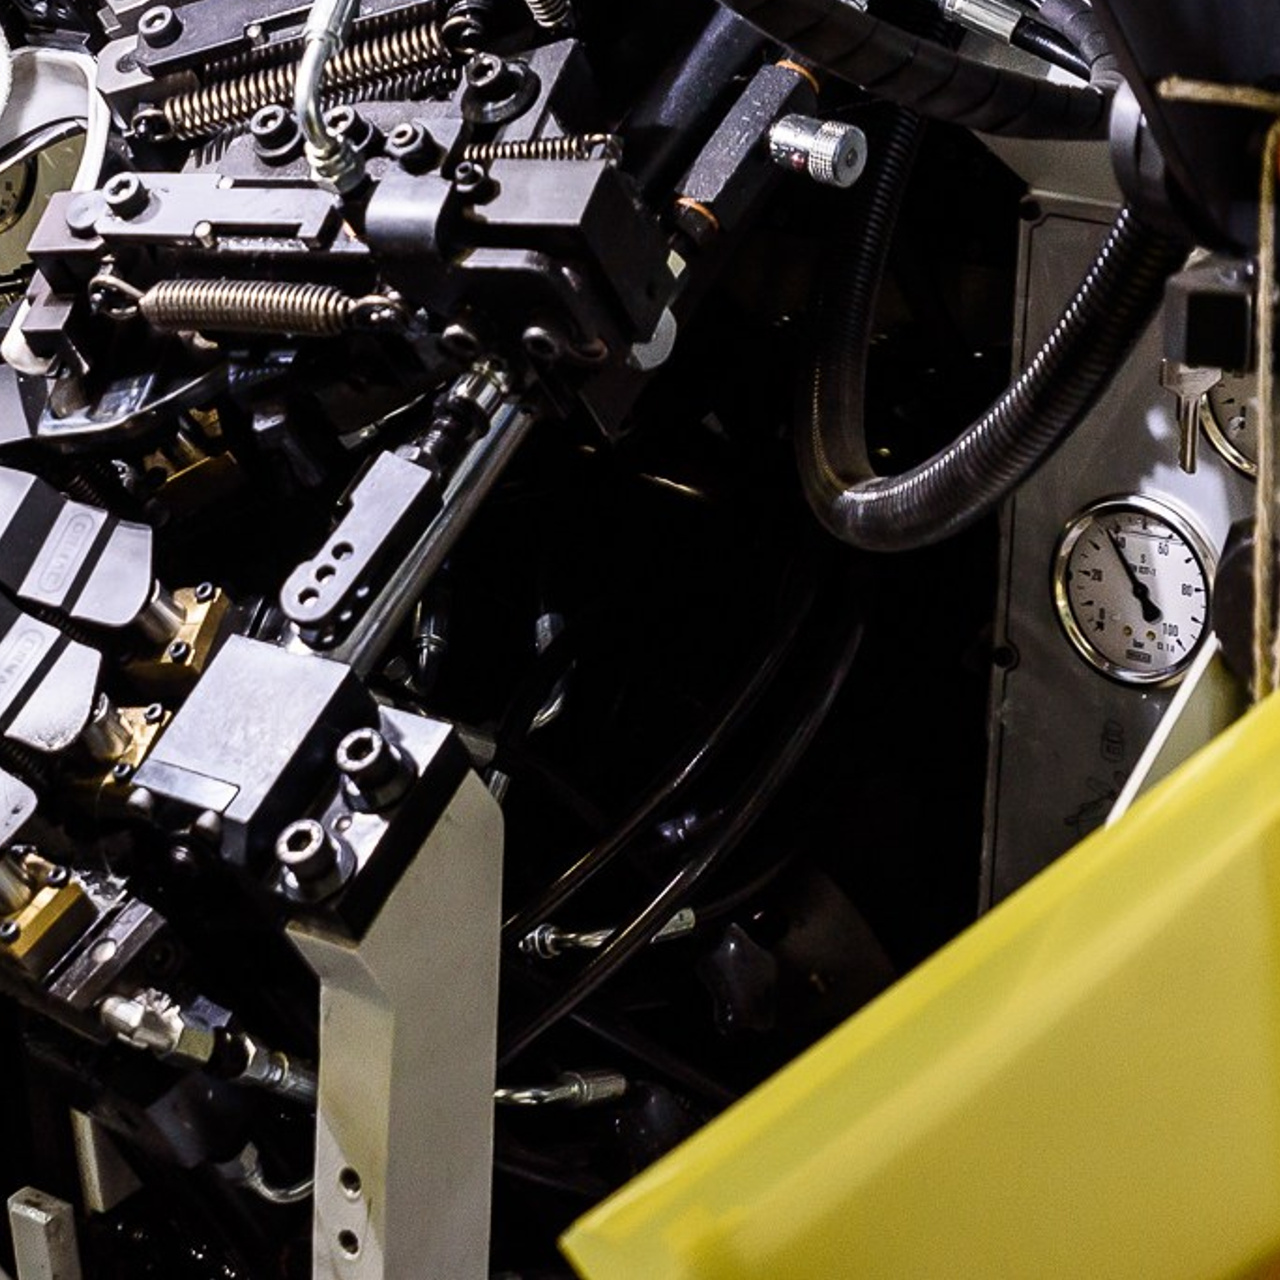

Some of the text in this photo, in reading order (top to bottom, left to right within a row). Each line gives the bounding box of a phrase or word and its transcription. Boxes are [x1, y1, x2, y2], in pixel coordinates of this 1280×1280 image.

[1158, 541, 1169, 556] 60
[1181, 583, 1193, 597] 80
[1162, 622, 1179, 637] 100
